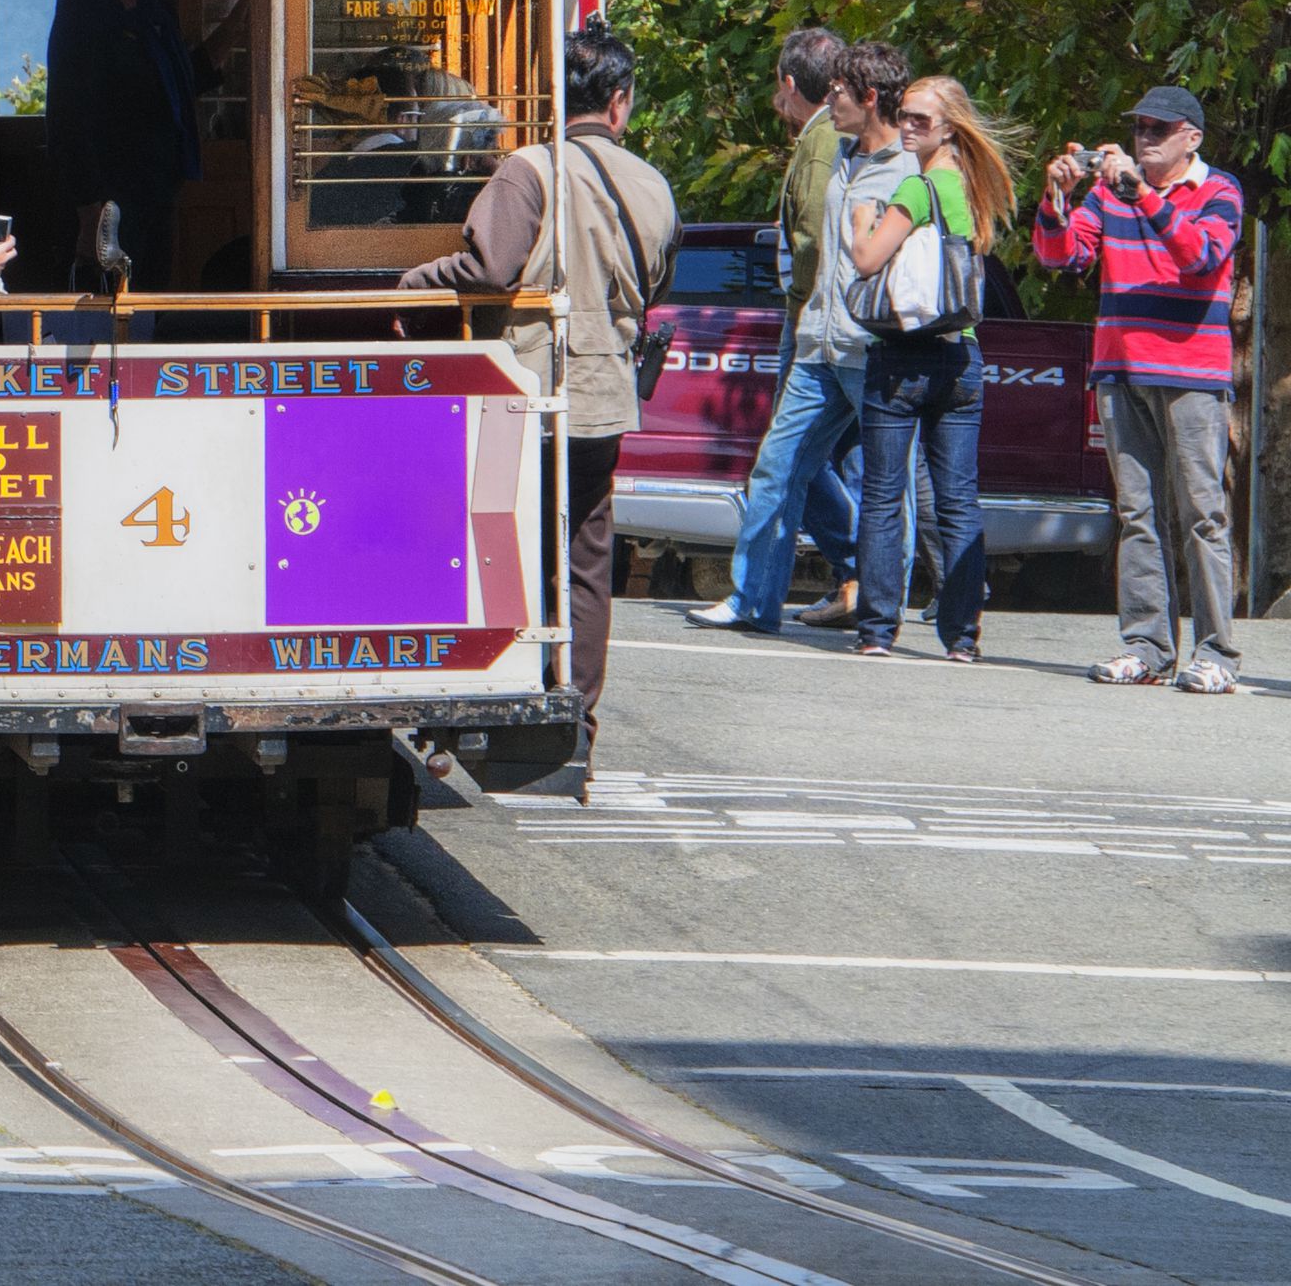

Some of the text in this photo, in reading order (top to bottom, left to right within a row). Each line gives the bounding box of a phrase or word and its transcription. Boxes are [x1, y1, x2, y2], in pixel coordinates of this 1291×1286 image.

[346, 0, 381, 18] FARE
[155, 360, 380, 397] STREET
[403, 358, 433, 392] &
[662, 350, 782, 374] ODGE
[120, 485, 191, 547] 4
[269, 633, 457, 671] WHARF
